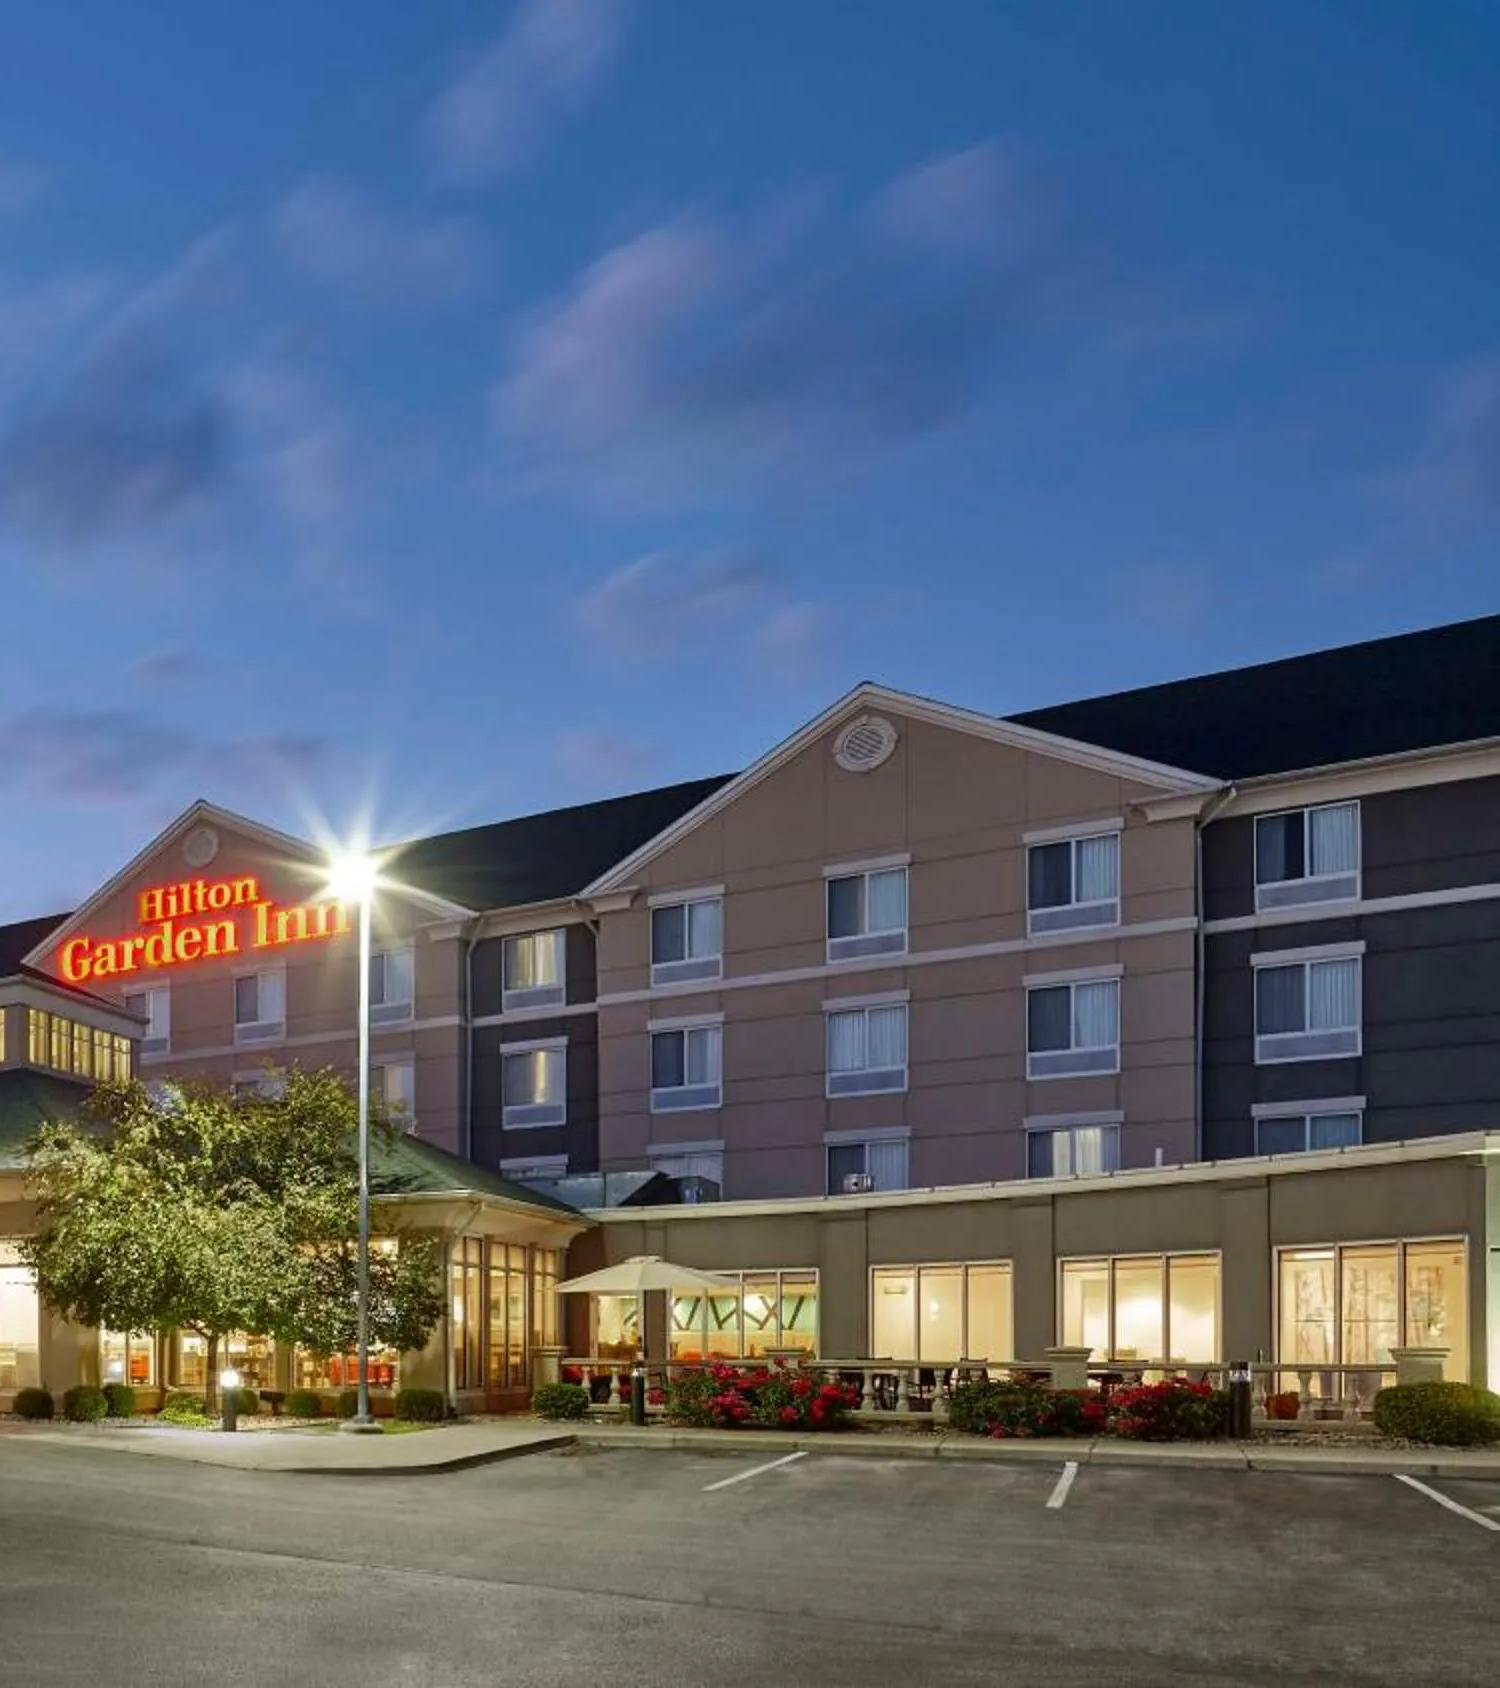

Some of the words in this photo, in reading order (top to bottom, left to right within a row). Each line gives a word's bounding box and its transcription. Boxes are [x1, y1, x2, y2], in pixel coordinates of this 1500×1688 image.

[139, 877, 259, 922] Hilton
[61, 919, 240, 982] Garden
[251, 898, 353, 948] Inn
